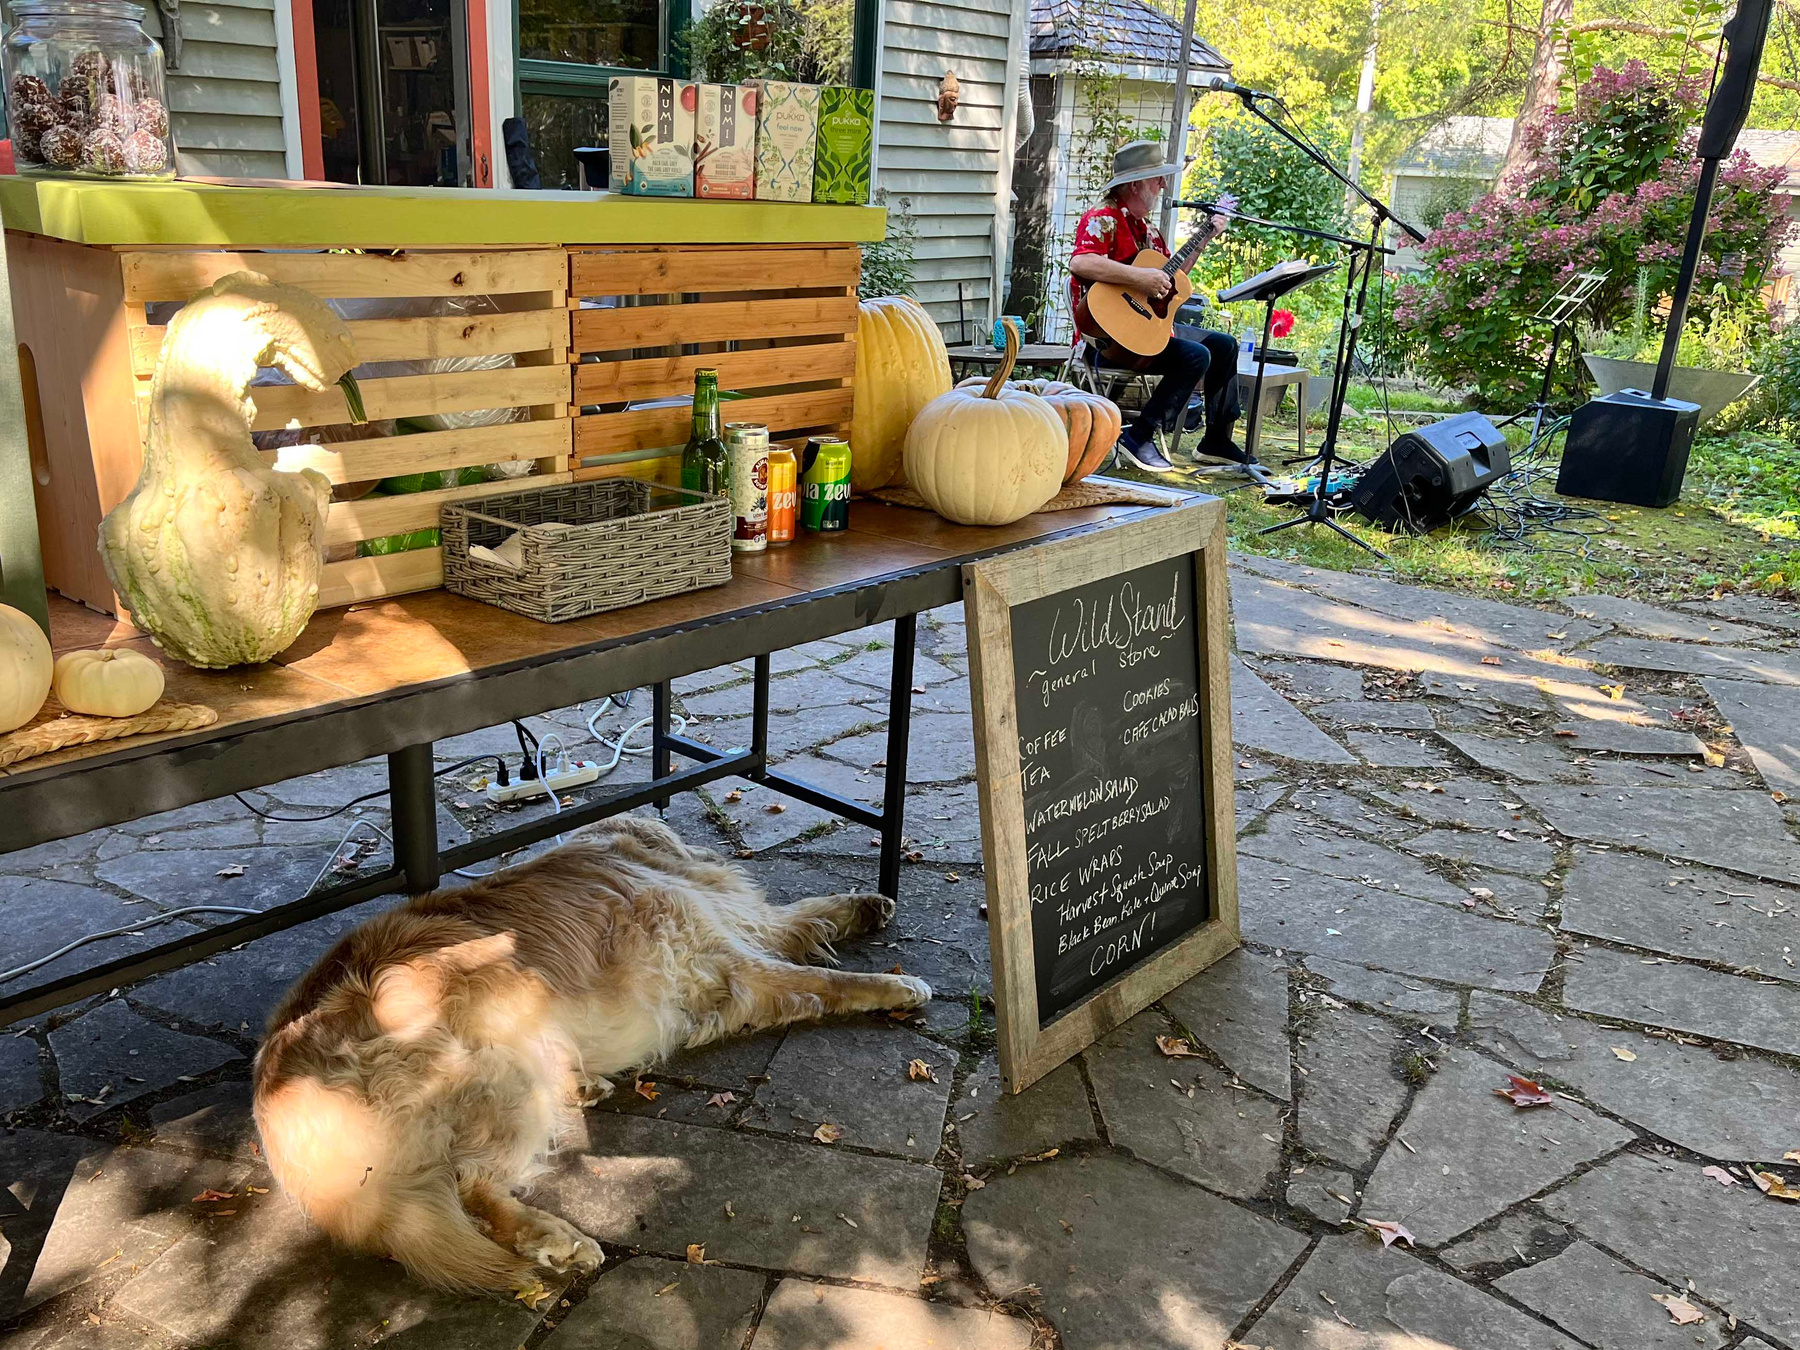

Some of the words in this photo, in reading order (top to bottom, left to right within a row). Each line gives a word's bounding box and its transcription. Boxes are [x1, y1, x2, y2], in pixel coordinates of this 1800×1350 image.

[660, 85, 672, 135] NUMI
[722, 90, 733, 139] NUMI
[776, 111, 805, 122] pukka
[776, 122, 789, 131] feel
[789, 124, 804, 132] new
[832, 116, 861, 126] pukka
[846, 127, 862, 135] mint
[1041, 659, 1097, 707] general
[1179, 692, 1199, 722] BALLS
[1021, 761, 1051, 792] TEA
[1025, 775, 1103, 835] WATERMELON
[1104, 776, 1139, 805] SALAD
[1027, 840, 1070, 874] FALL
[1074, 817, 1111, 849] SPELT
[1111, 805, 1141, 831] BERRY
[1139, 796, 1171, 823] SALAD
[1031, 871, 1072, 911] RICE
[1079, 844, 1123, 886] WRAPS
[1056, 882, 1109, 926] Harvest
[1110, 864, 1147, 903] Squash
[1148, 851, 1174, 876] Soup
[1058, 925, 1091, 955] Black
[1177, 862, 1202, 889] Soup
